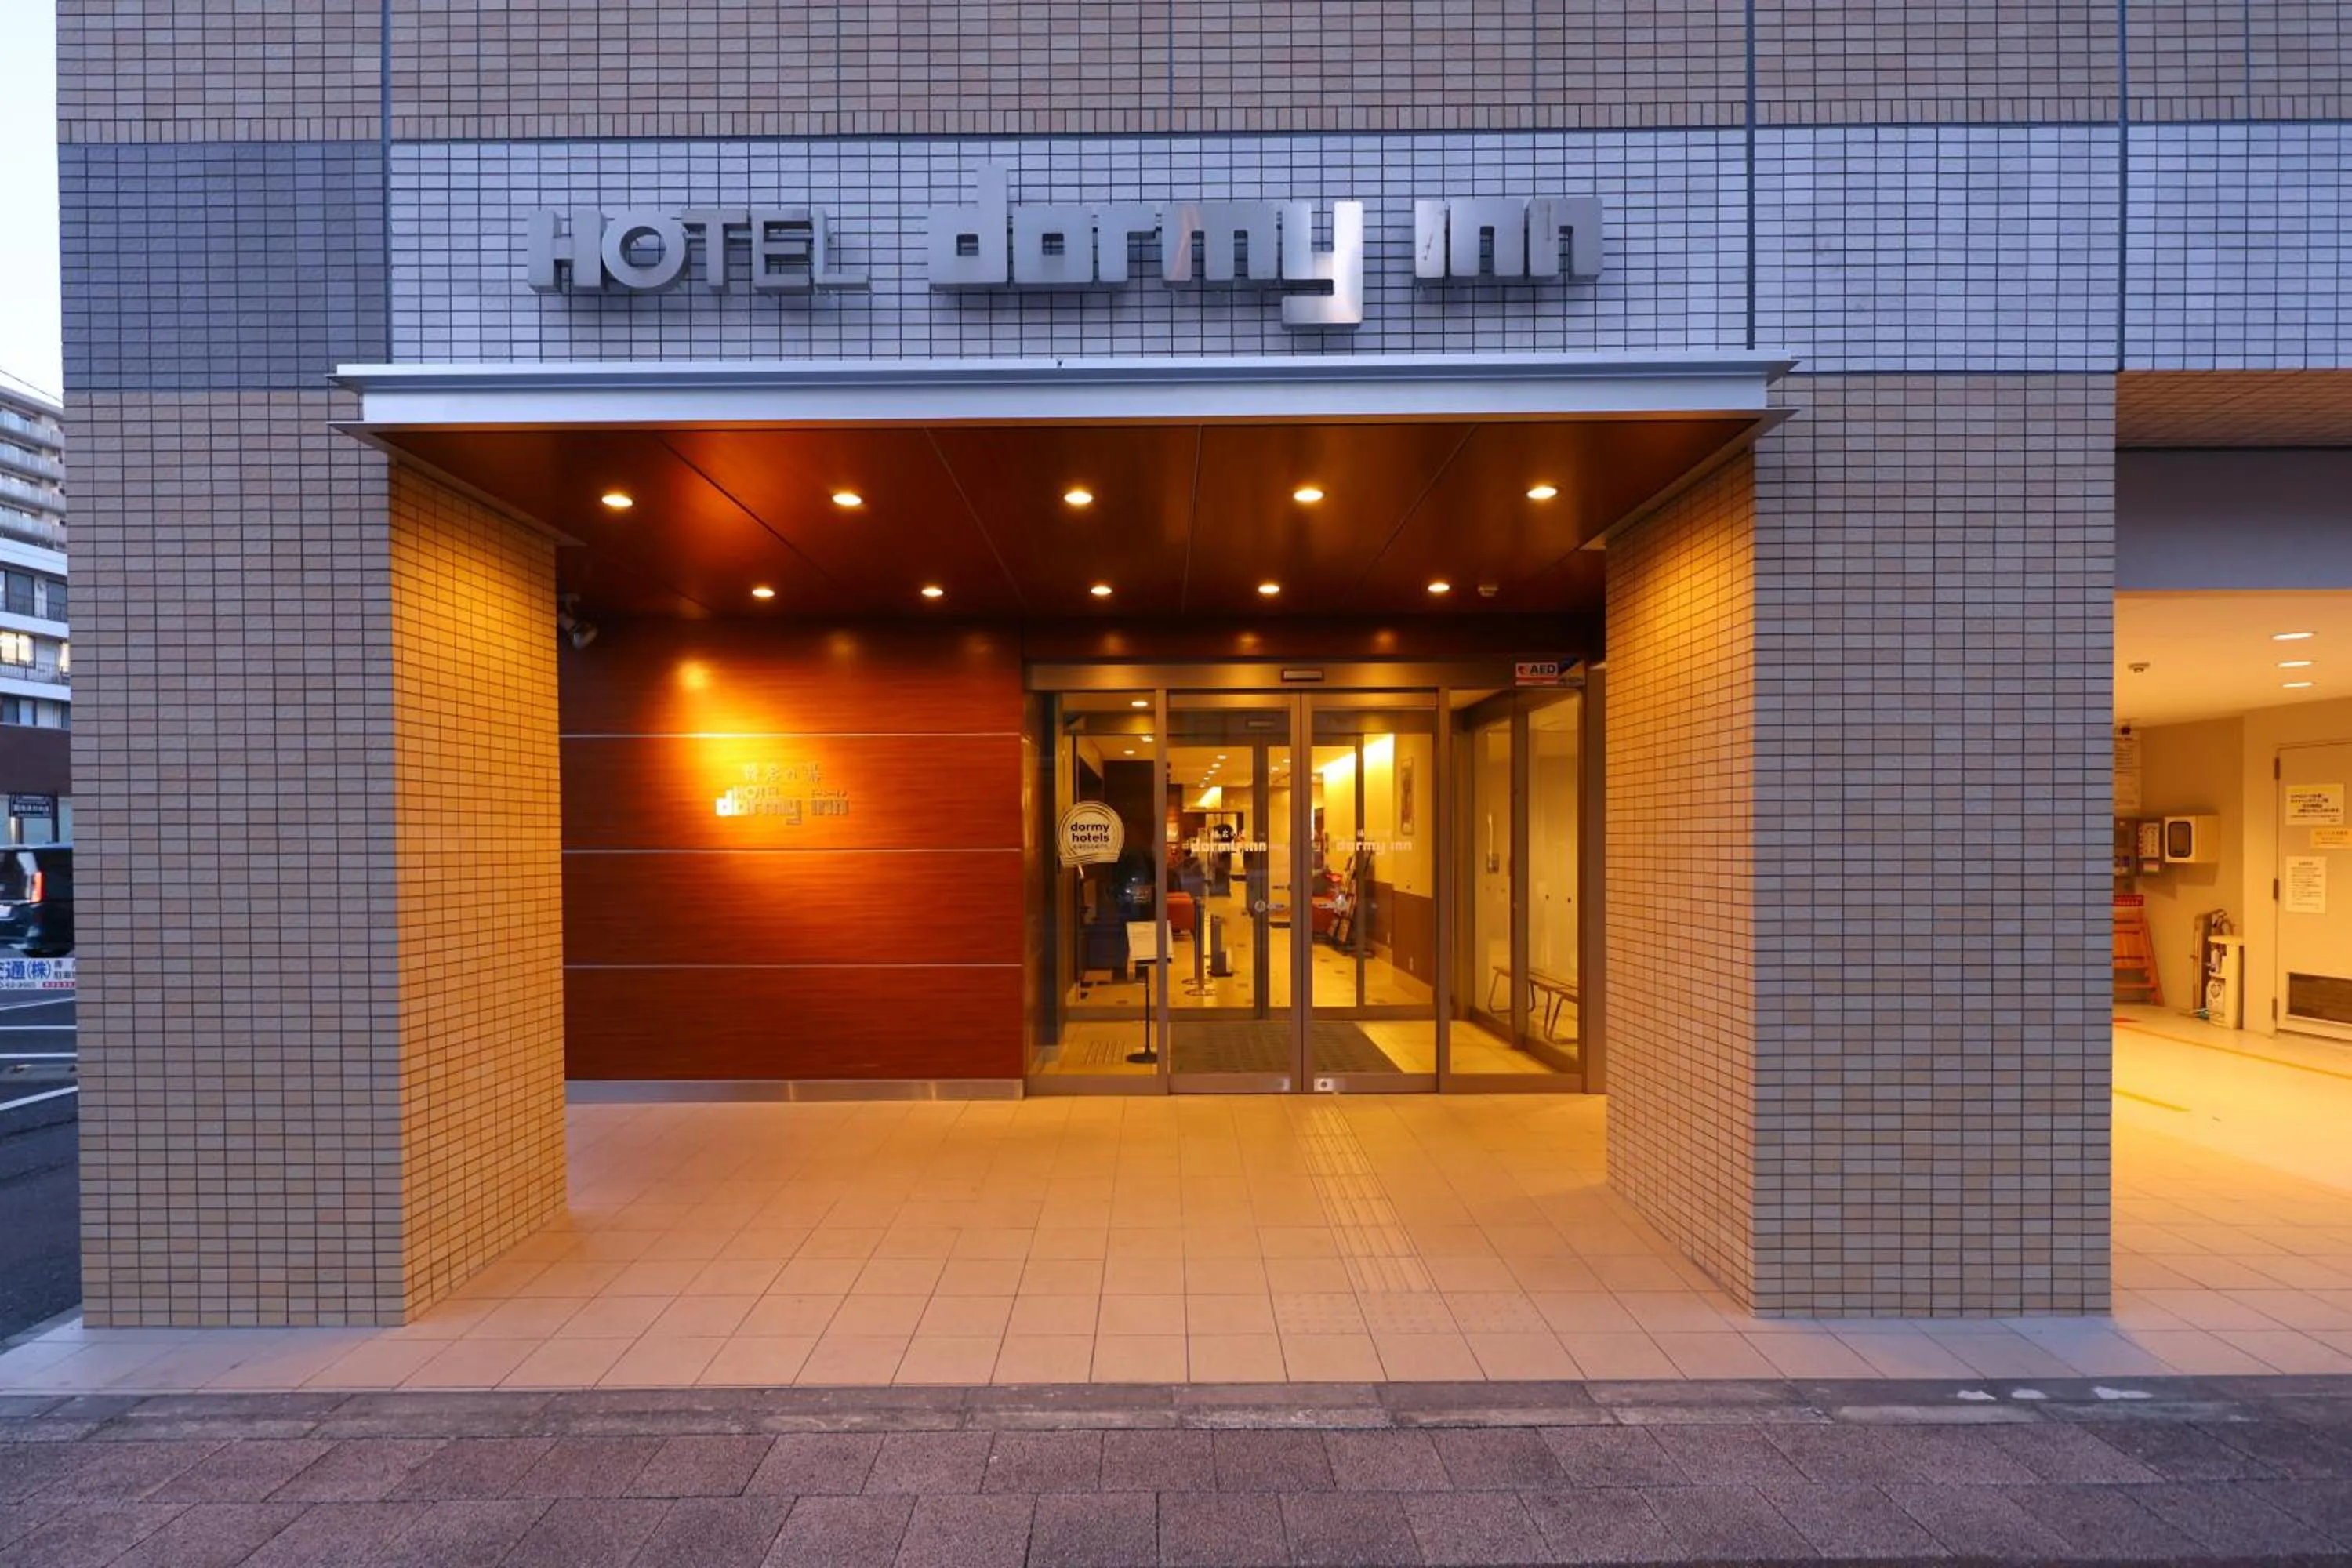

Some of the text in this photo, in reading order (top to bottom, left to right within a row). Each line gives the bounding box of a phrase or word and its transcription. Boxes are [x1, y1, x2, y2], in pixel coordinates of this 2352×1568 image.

[527, 162, 1604, 329] HOTEL dormy inn
[1530, 664, 1556, 673] AED
[715, 788, 849, 826] dormy inn
[1070, 821, 1109, 833] dormy
[1072, 833, 1109, 843] hotels
[1190, 837, 1244, 856] dormy
[1336, 837, 1386, 855] dormy
